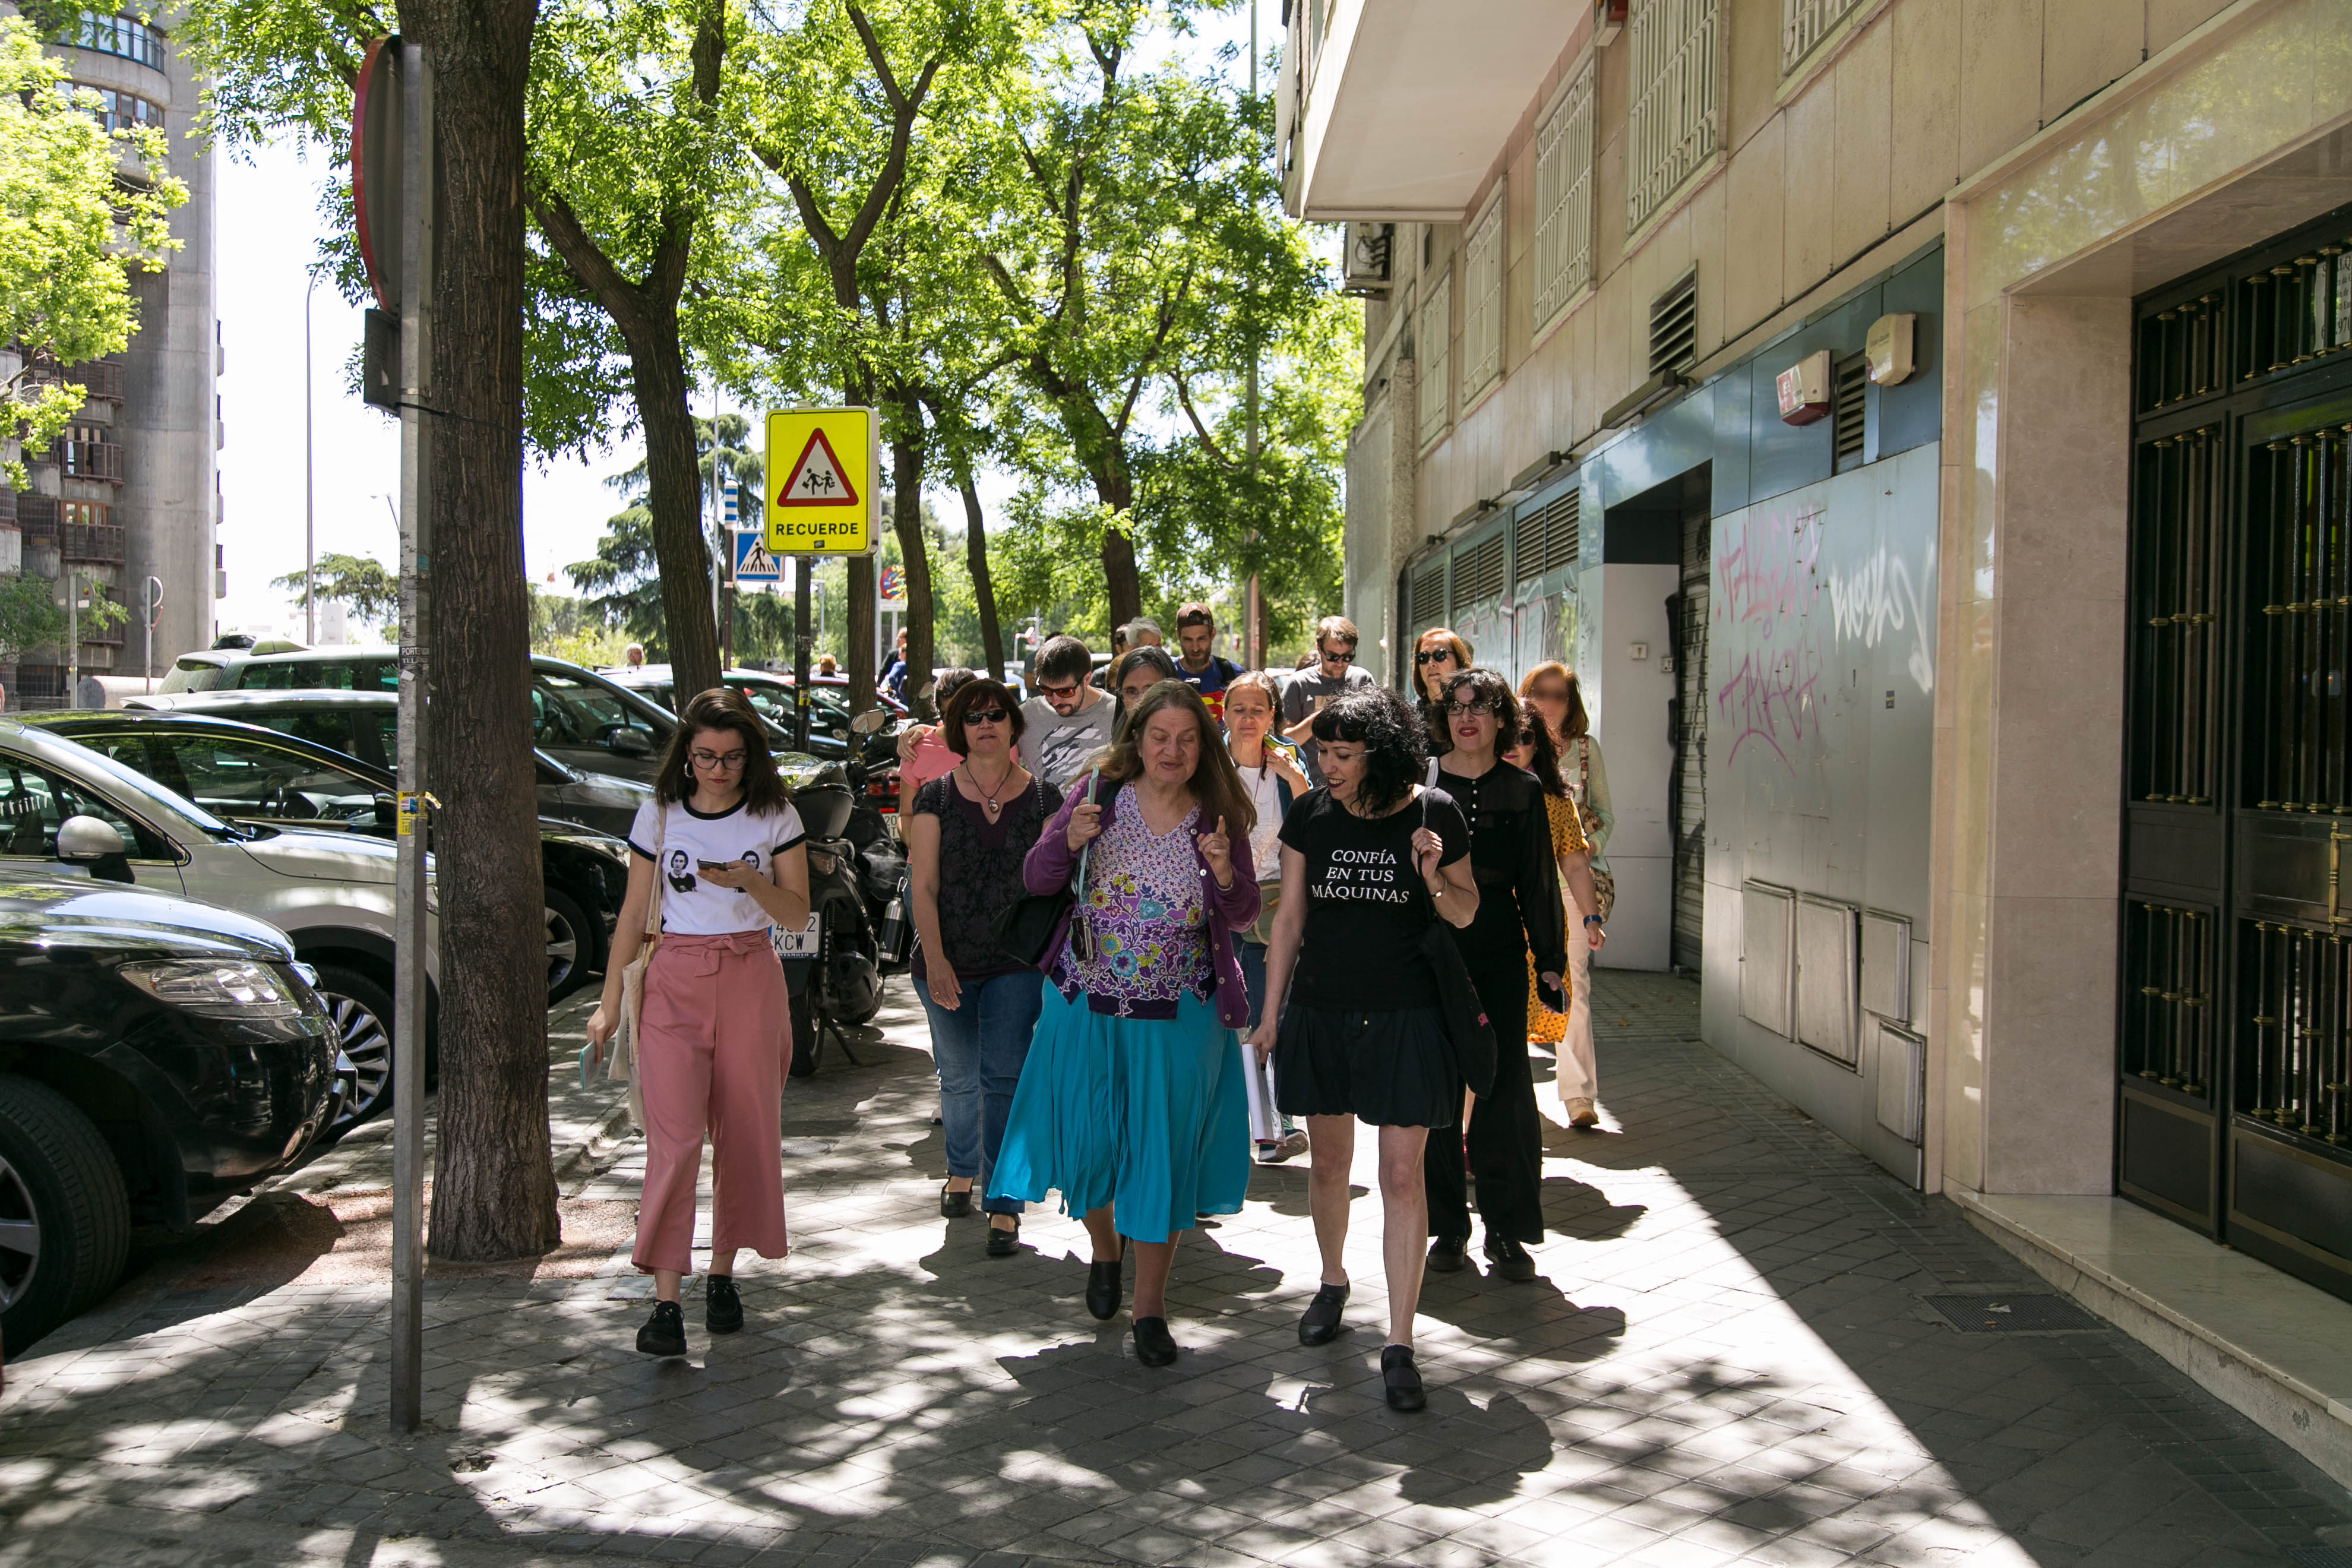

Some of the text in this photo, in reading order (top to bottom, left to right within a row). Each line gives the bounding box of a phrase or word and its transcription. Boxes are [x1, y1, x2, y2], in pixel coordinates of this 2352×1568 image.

[776, 523, 859, 535] RECUERDE
[1332, 849, 1397, 864] CONFÍA
[1326, 867, 1393, 882] EN TUS
[1311, 881, 1409, 903] MÁQUINAS
[776, 916, 816, 932] 42
[774, 934, 804, 950] KCW
